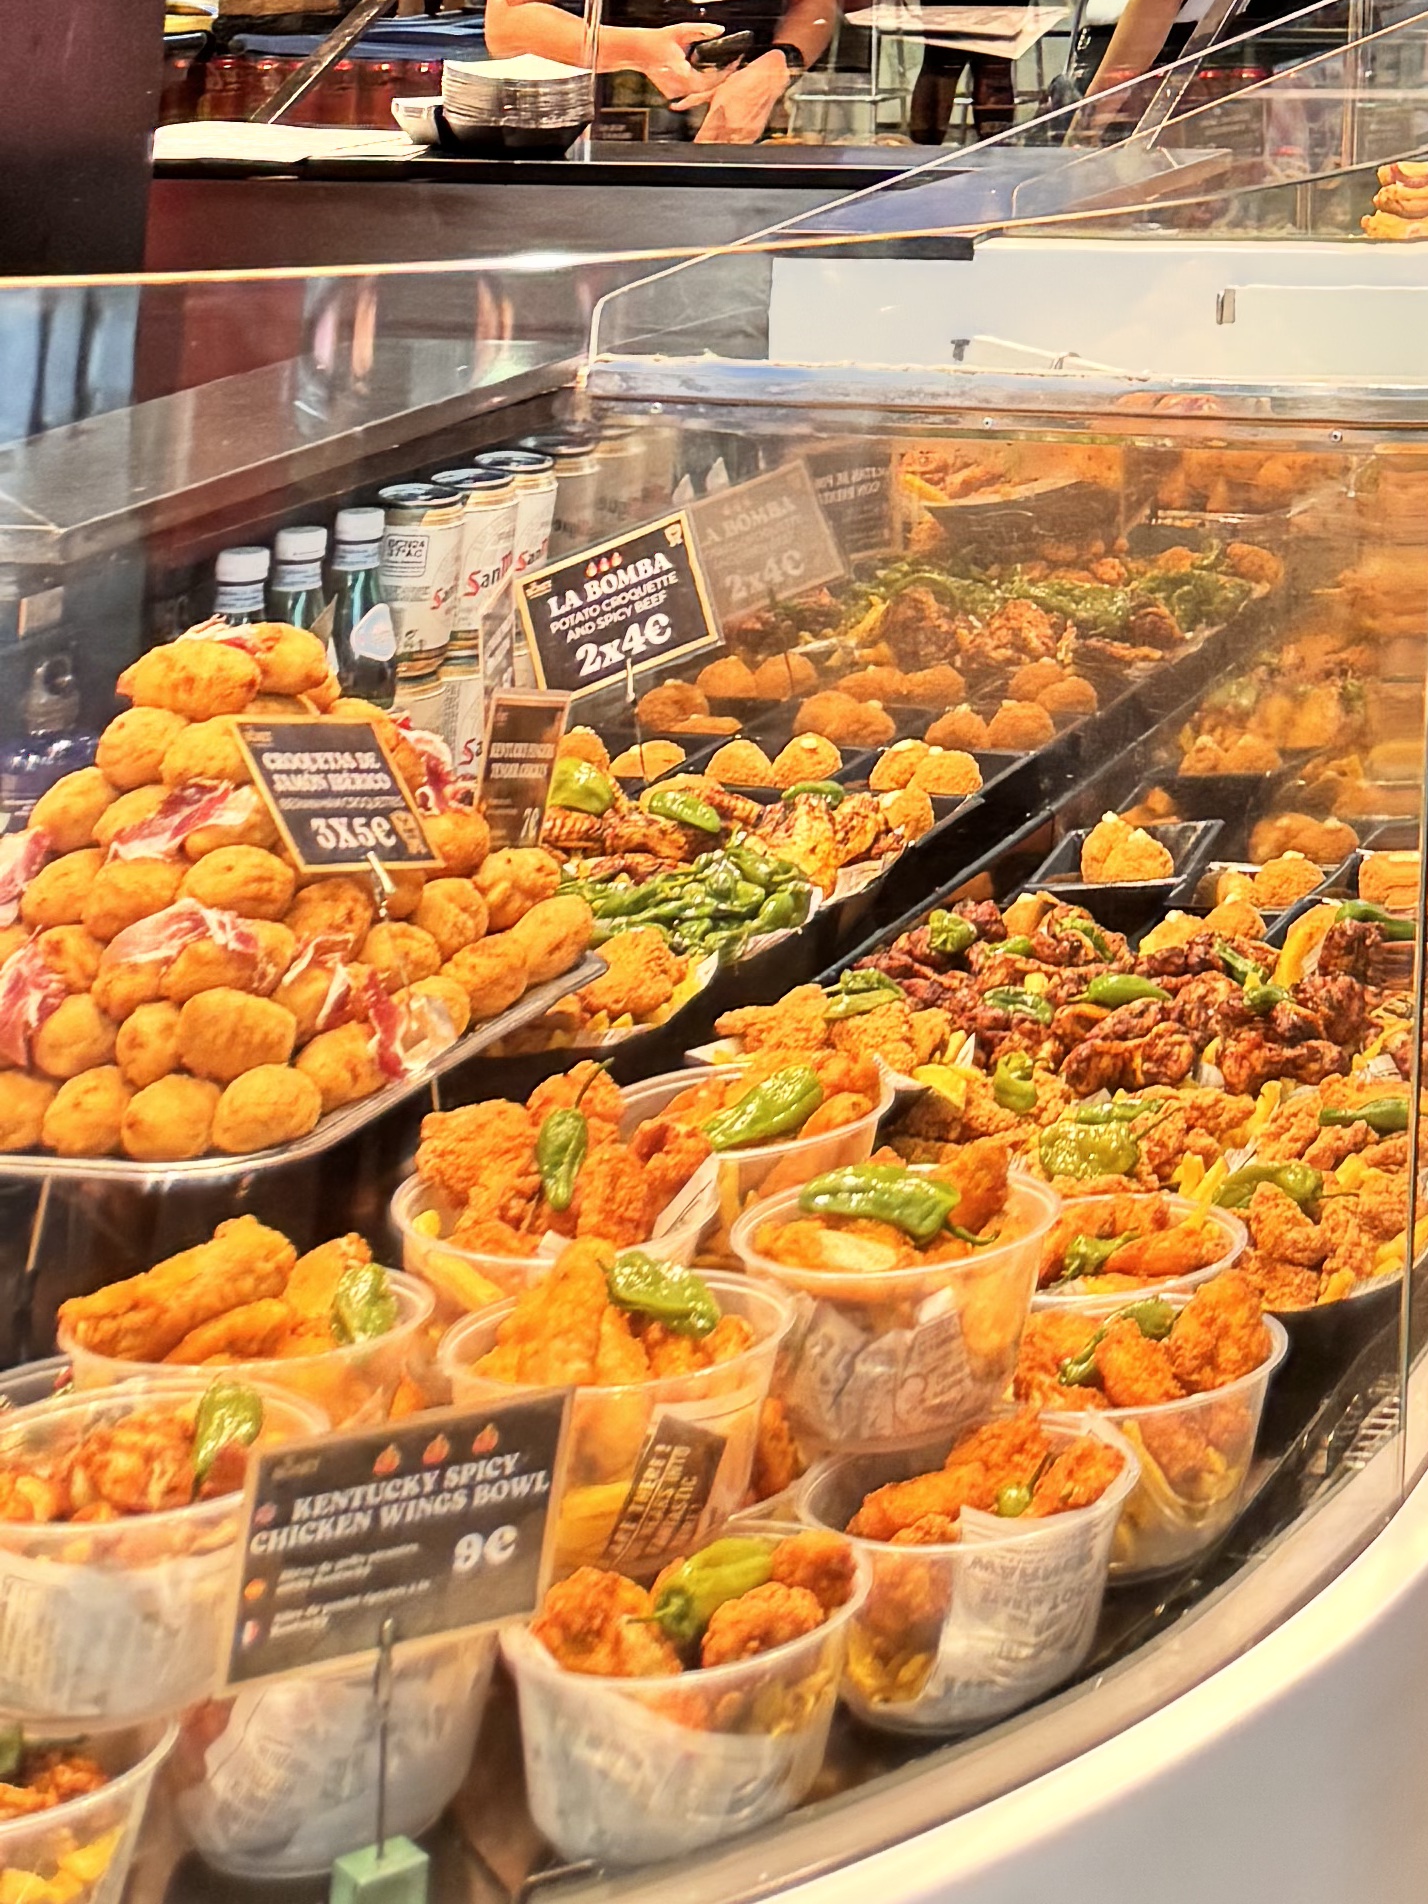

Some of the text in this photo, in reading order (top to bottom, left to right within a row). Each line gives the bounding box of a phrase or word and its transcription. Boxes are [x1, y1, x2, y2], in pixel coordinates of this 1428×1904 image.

[546, 589, 583, 619] LA
[583, 552, 674, 604] BOMBA
[549, 571, 679, 634] POTATO CROQUETTE
[566, 590, 668, 643] AND SPICY BEEF
[575, 613, 673, 678] 2x4€
[262, 751, 381, 771] CROQUETAS DE
[249, 1471, 550, 1555] CHICKEN WINGS BOWL
[291, 1452, 520, 1524] KENTUCKY SPICY
